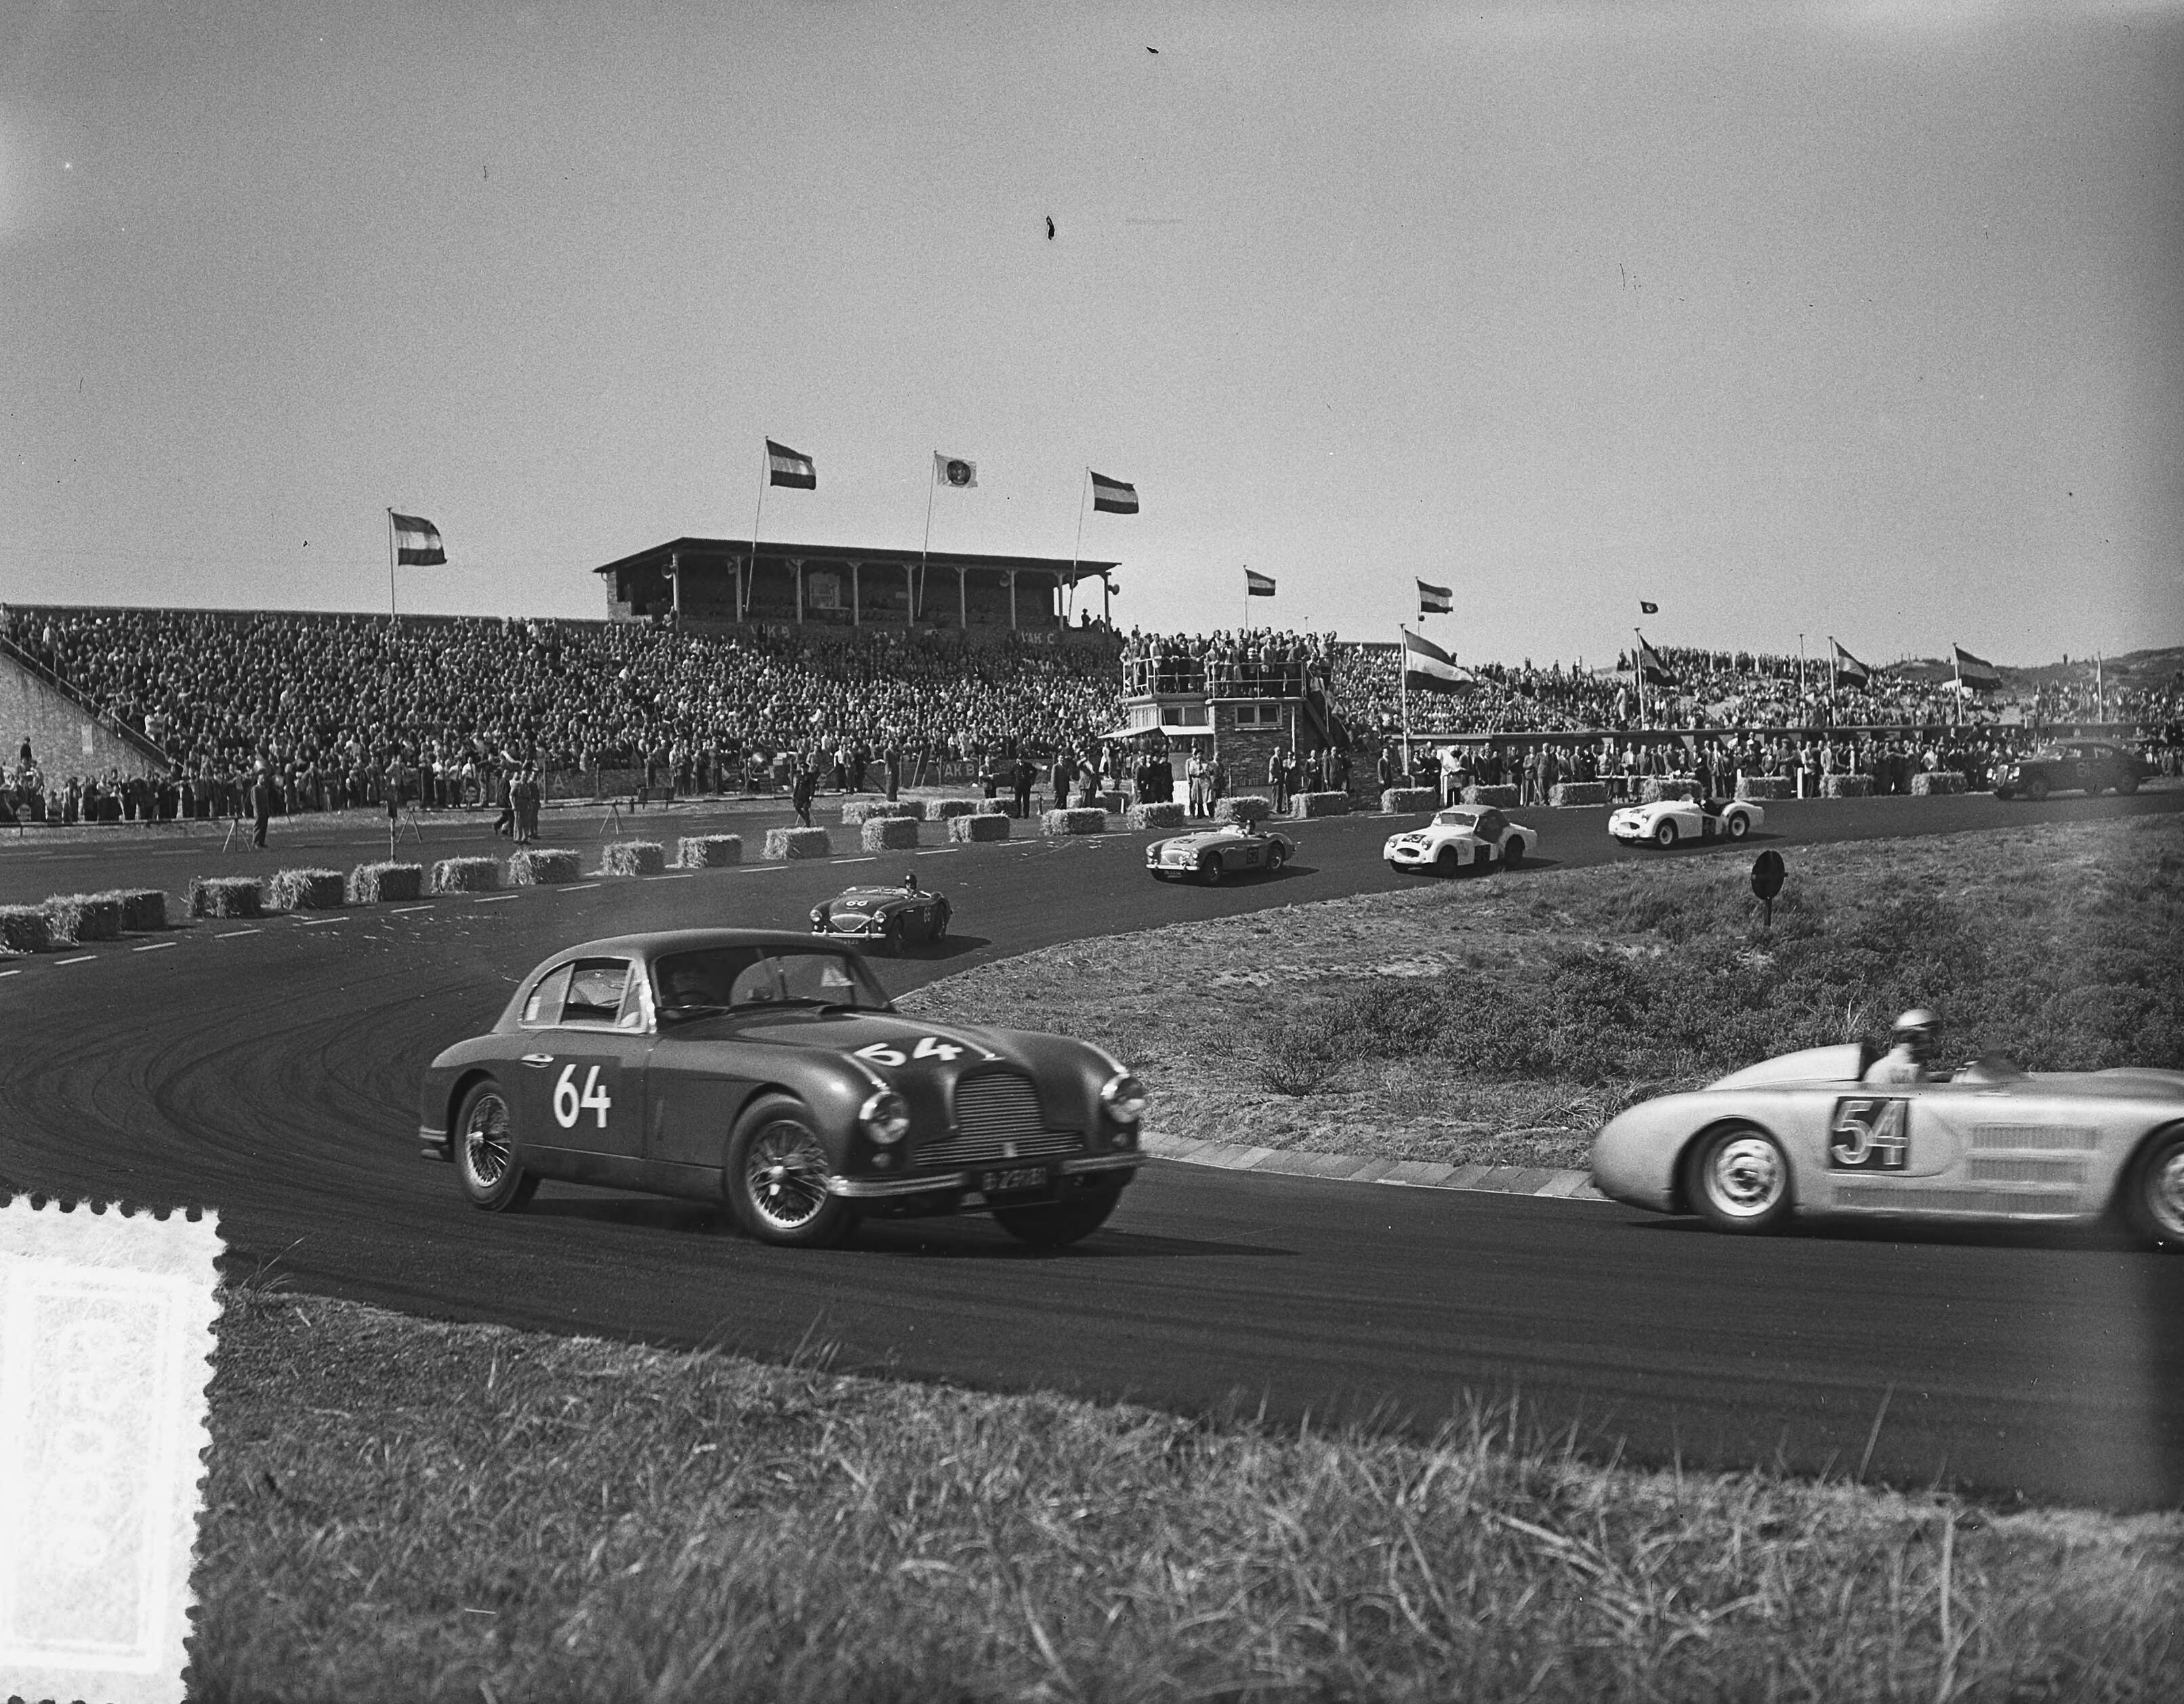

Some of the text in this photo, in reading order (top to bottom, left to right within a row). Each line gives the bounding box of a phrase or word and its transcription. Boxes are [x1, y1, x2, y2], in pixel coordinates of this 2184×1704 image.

[966, 764, 974, 777] B
[853, 1037, 964, 1066] 64
[554, 1064, 611, 1128] 64
[1829, 1099, 1909, 1165] 54
